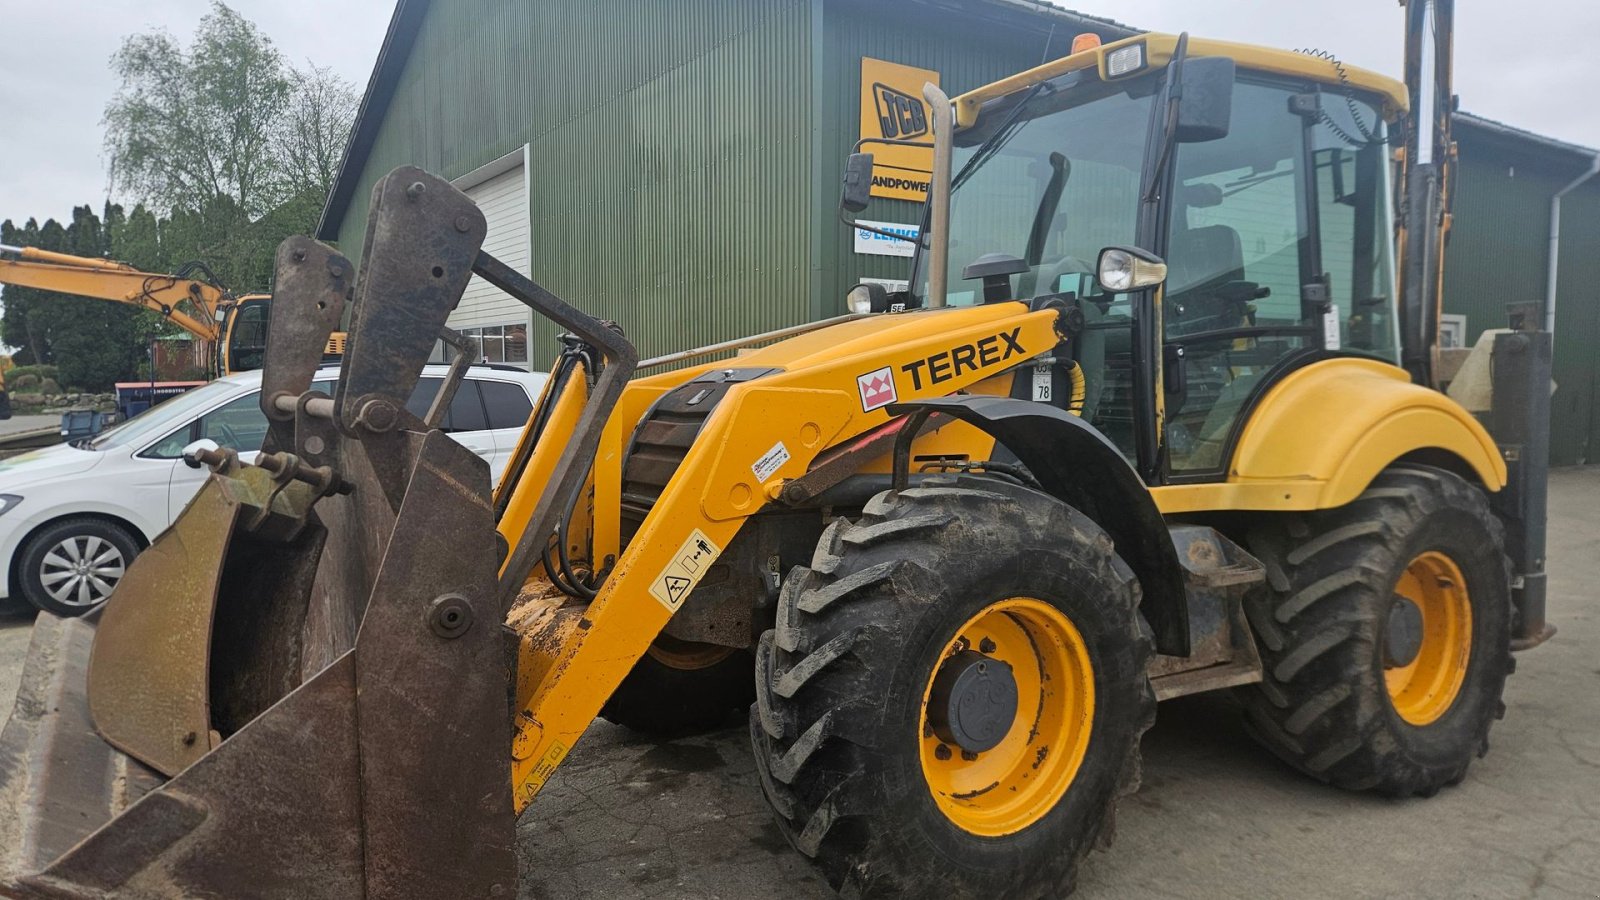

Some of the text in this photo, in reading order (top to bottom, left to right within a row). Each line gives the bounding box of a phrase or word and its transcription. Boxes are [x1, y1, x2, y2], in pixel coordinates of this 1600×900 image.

[882, 90, 925, 138] JCB
[871, 175, 930, 192] ANDPOWE
[901, 326, 1026, 391] TEREX
[1038, 386, 1050, 399] 78
